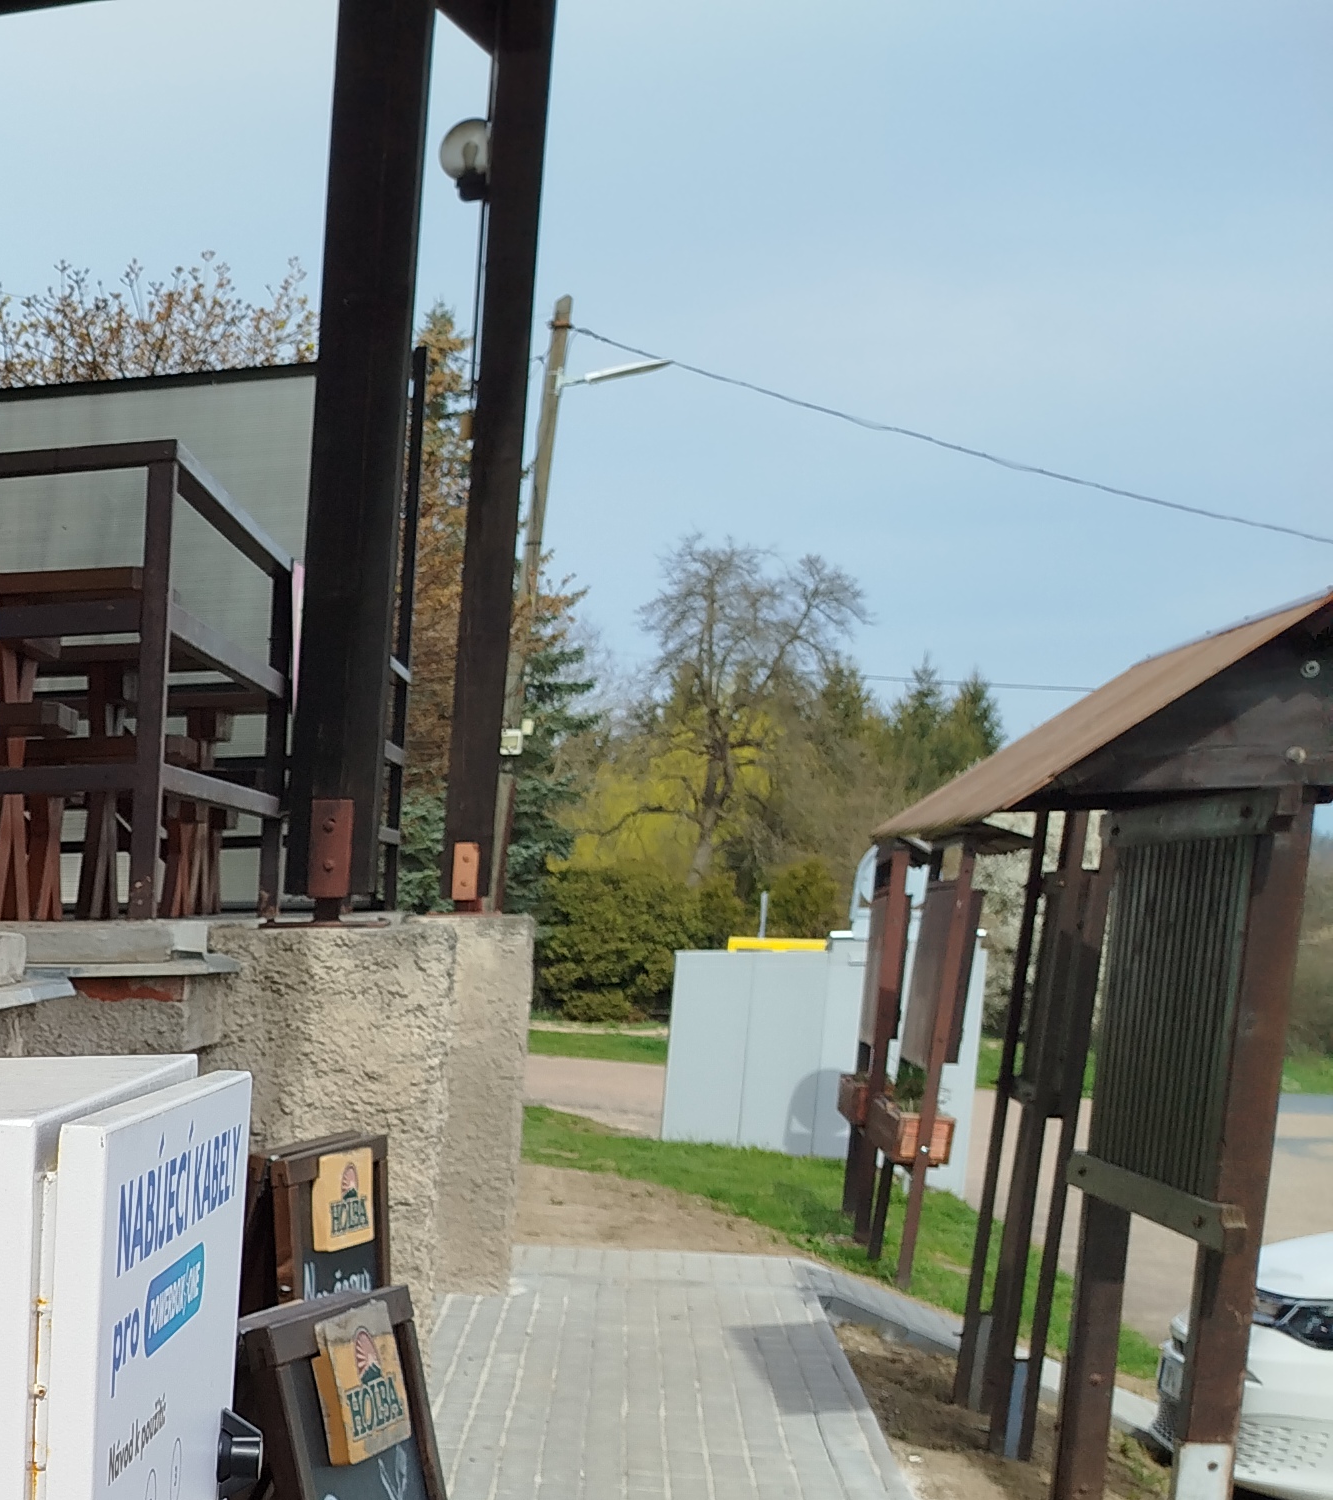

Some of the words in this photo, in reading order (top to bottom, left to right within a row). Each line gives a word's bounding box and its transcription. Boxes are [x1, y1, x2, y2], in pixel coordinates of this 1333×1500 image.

[116, 1119, 194, 1279] NABÍJECÍ
[191, 1123, 242, 1226] KABELY
[330, 1199, 369, 1237] HOLBA
[111, 1307, 140, 1398] pro
[345, 1374, 403, 1442] HOLBA
[107, 1422, 135, 1486] Návod
[135, 1418, 140, 1457] k
